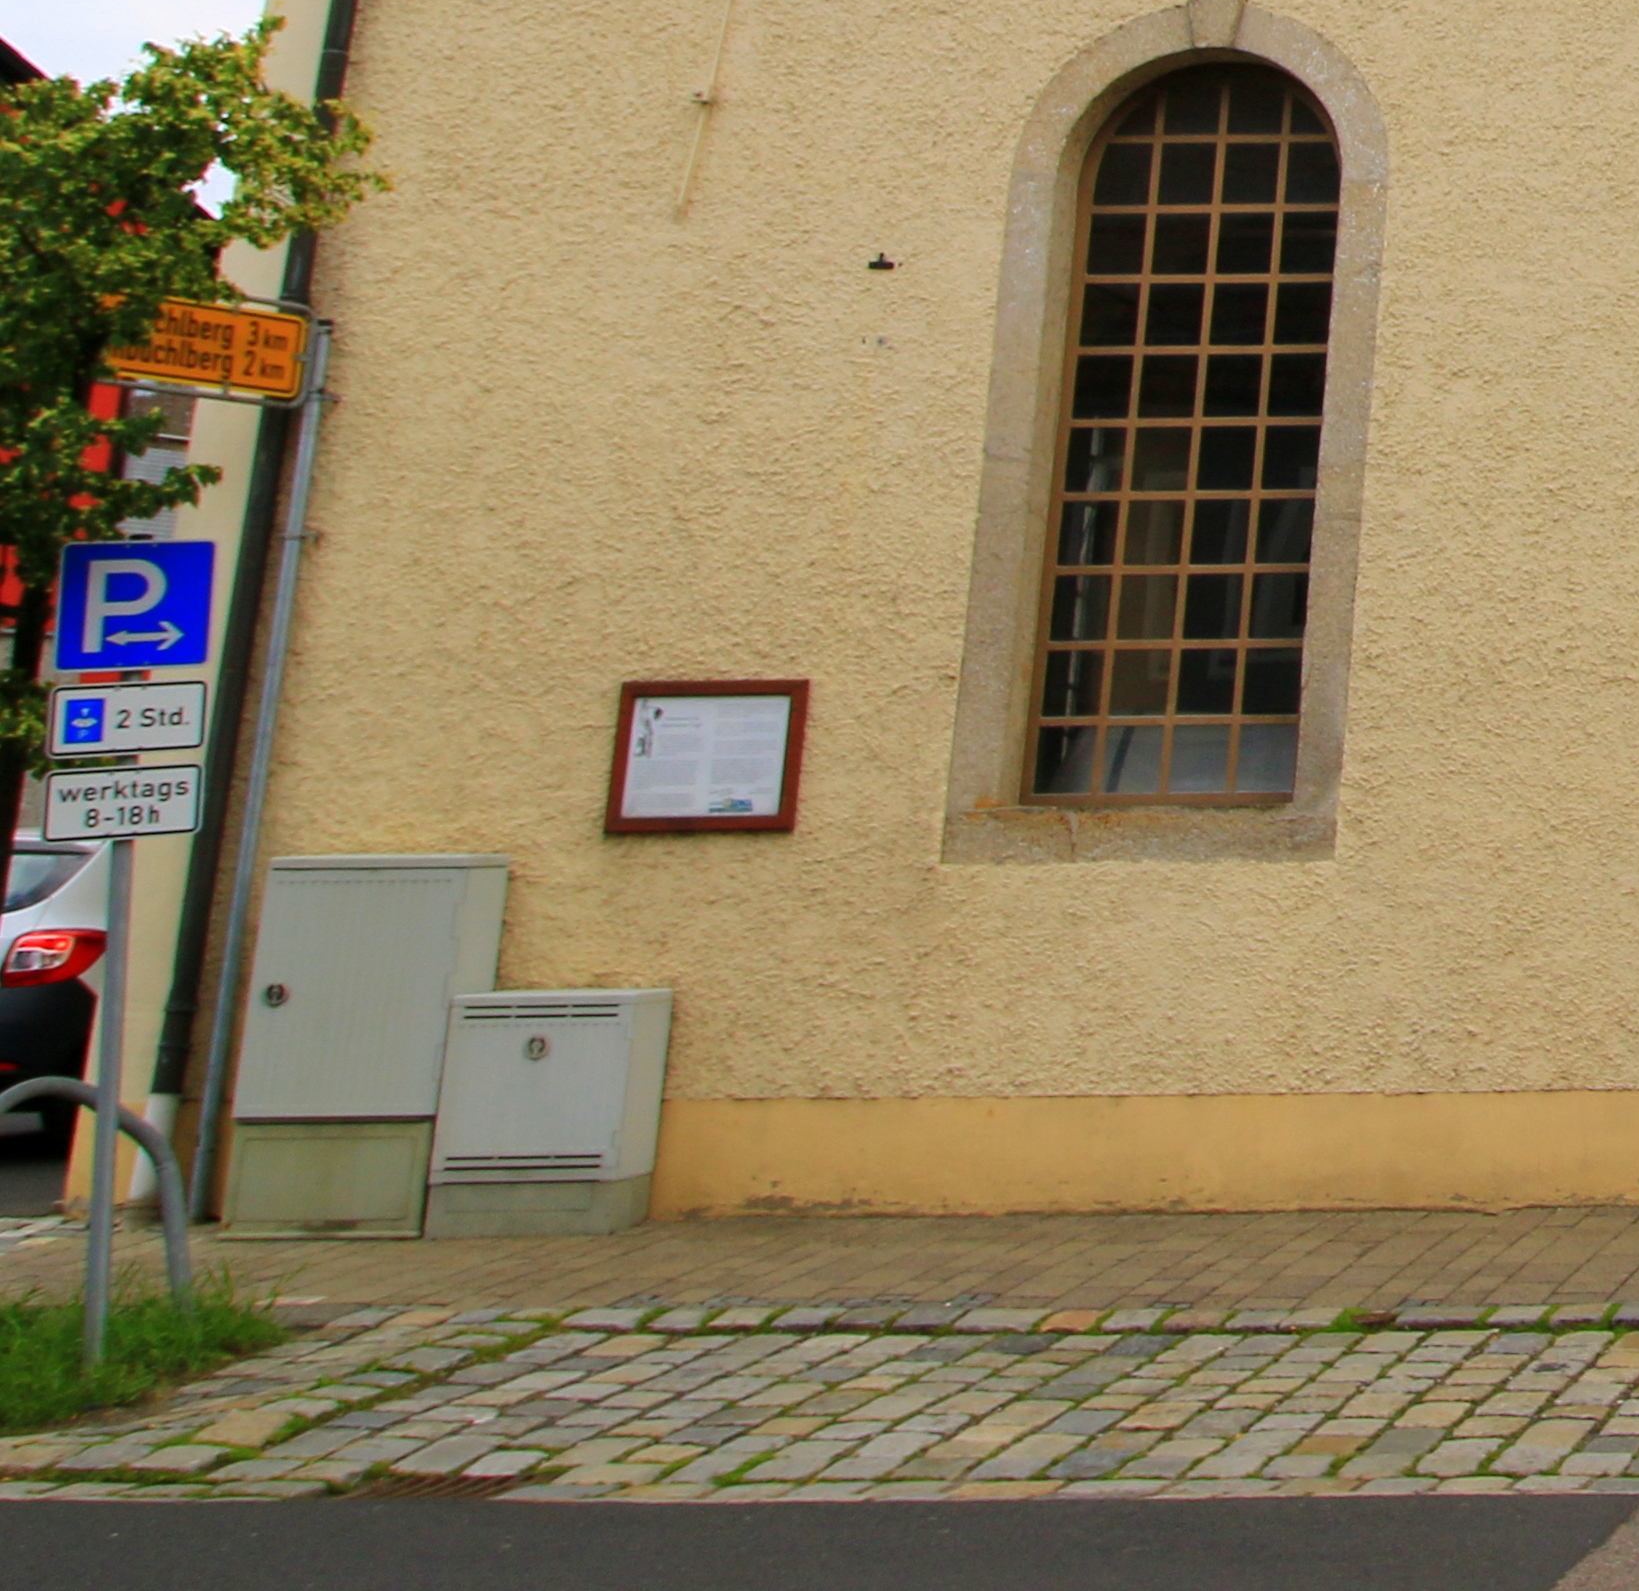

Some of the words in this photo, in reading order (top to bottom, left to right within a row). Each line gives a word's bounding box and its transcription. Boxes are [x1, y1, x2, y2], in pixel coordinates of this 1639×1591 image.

[248, 321, 259, 347] 3
[263, 328, 288, 350] km
[243, 350, 256, 377] 2
[259, 358, 285, 379] km
[81, 558, 168, 654] P
[116, 709, 132, 729] 2
[140, 706, 190, 728] Std.
[59, 779, 189, 803] werktags
